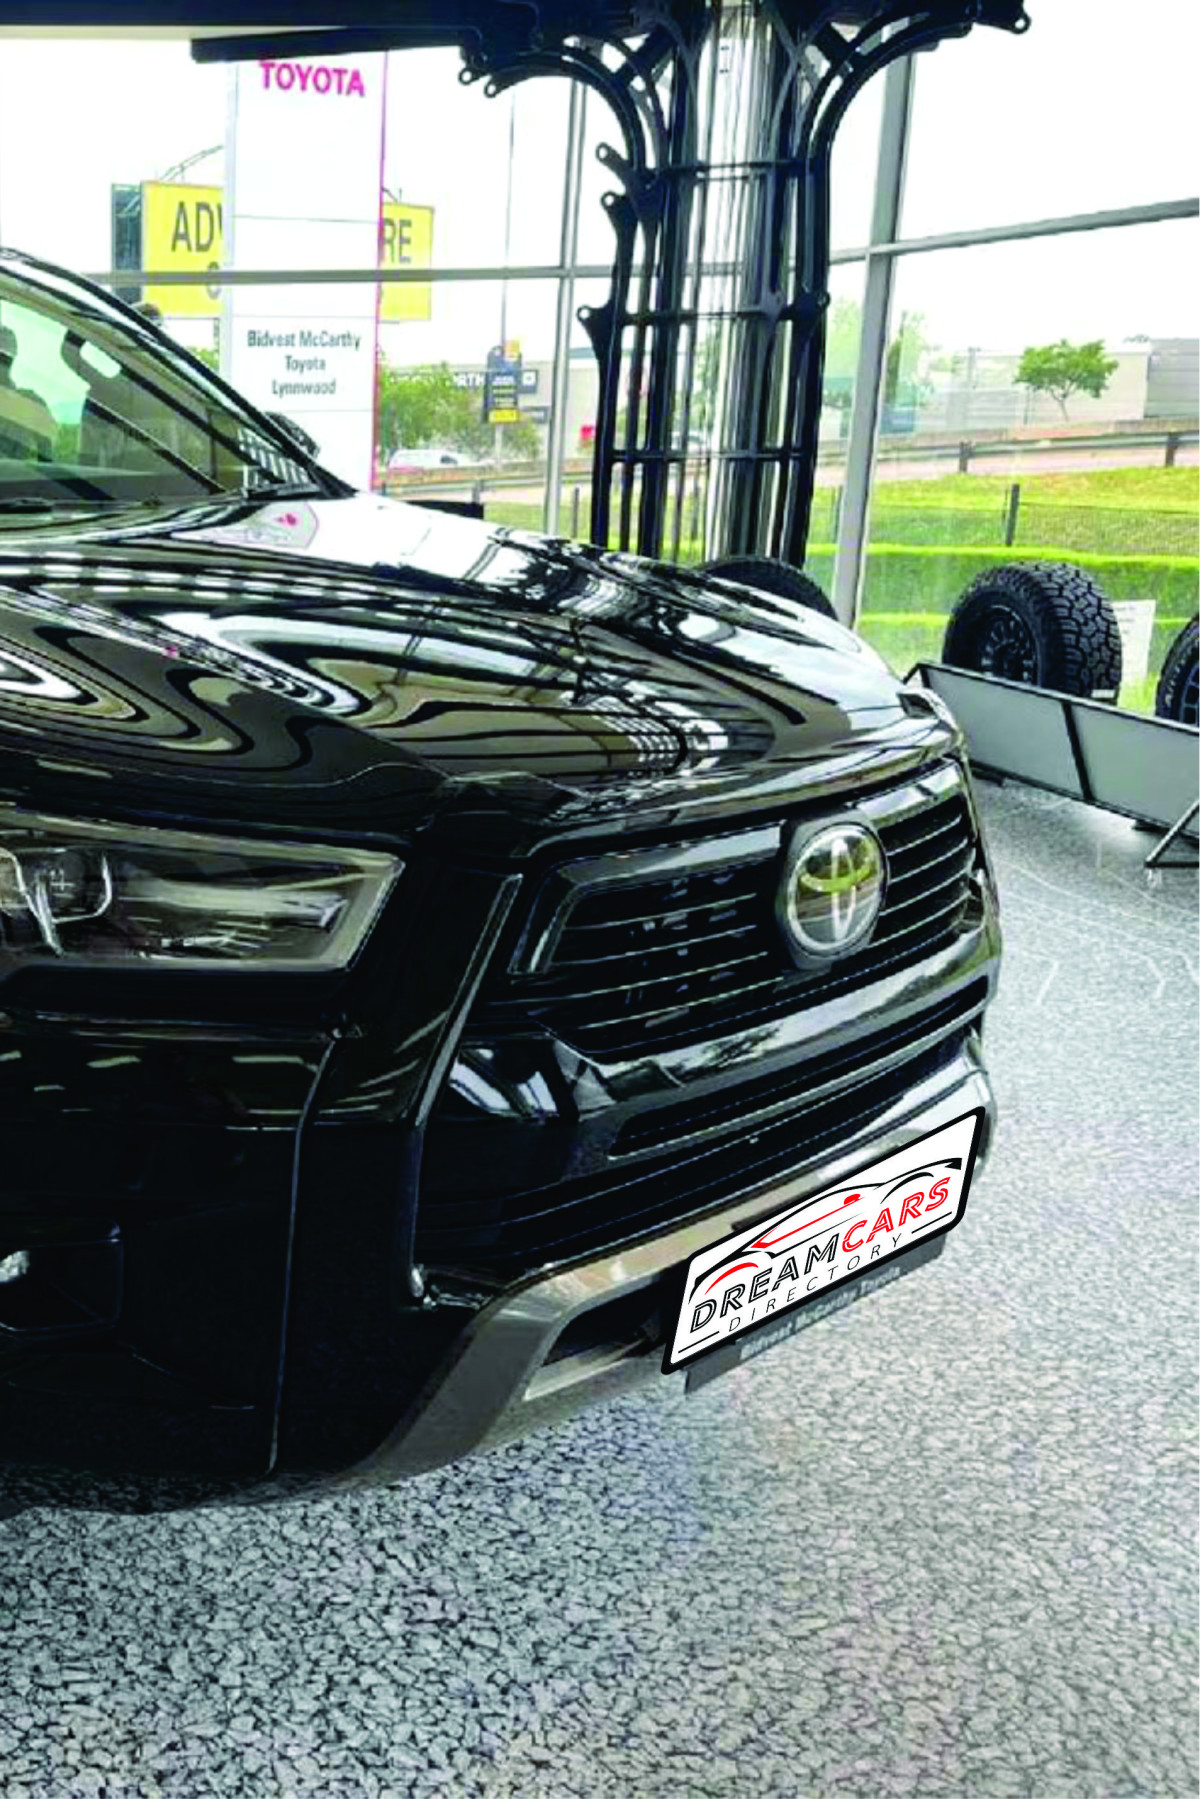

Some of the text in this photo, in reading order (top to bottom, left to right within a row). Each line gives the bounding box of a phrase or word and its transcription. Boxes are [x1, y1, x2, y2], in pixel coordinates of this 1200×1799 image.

[260, 62, 365, 97] TOYOTA
[247, 330, 361, 351] Bidvest McCarthy
[285, 355, 326, 374] Toyota
[272, 378, 337, 398] Lynnwood
